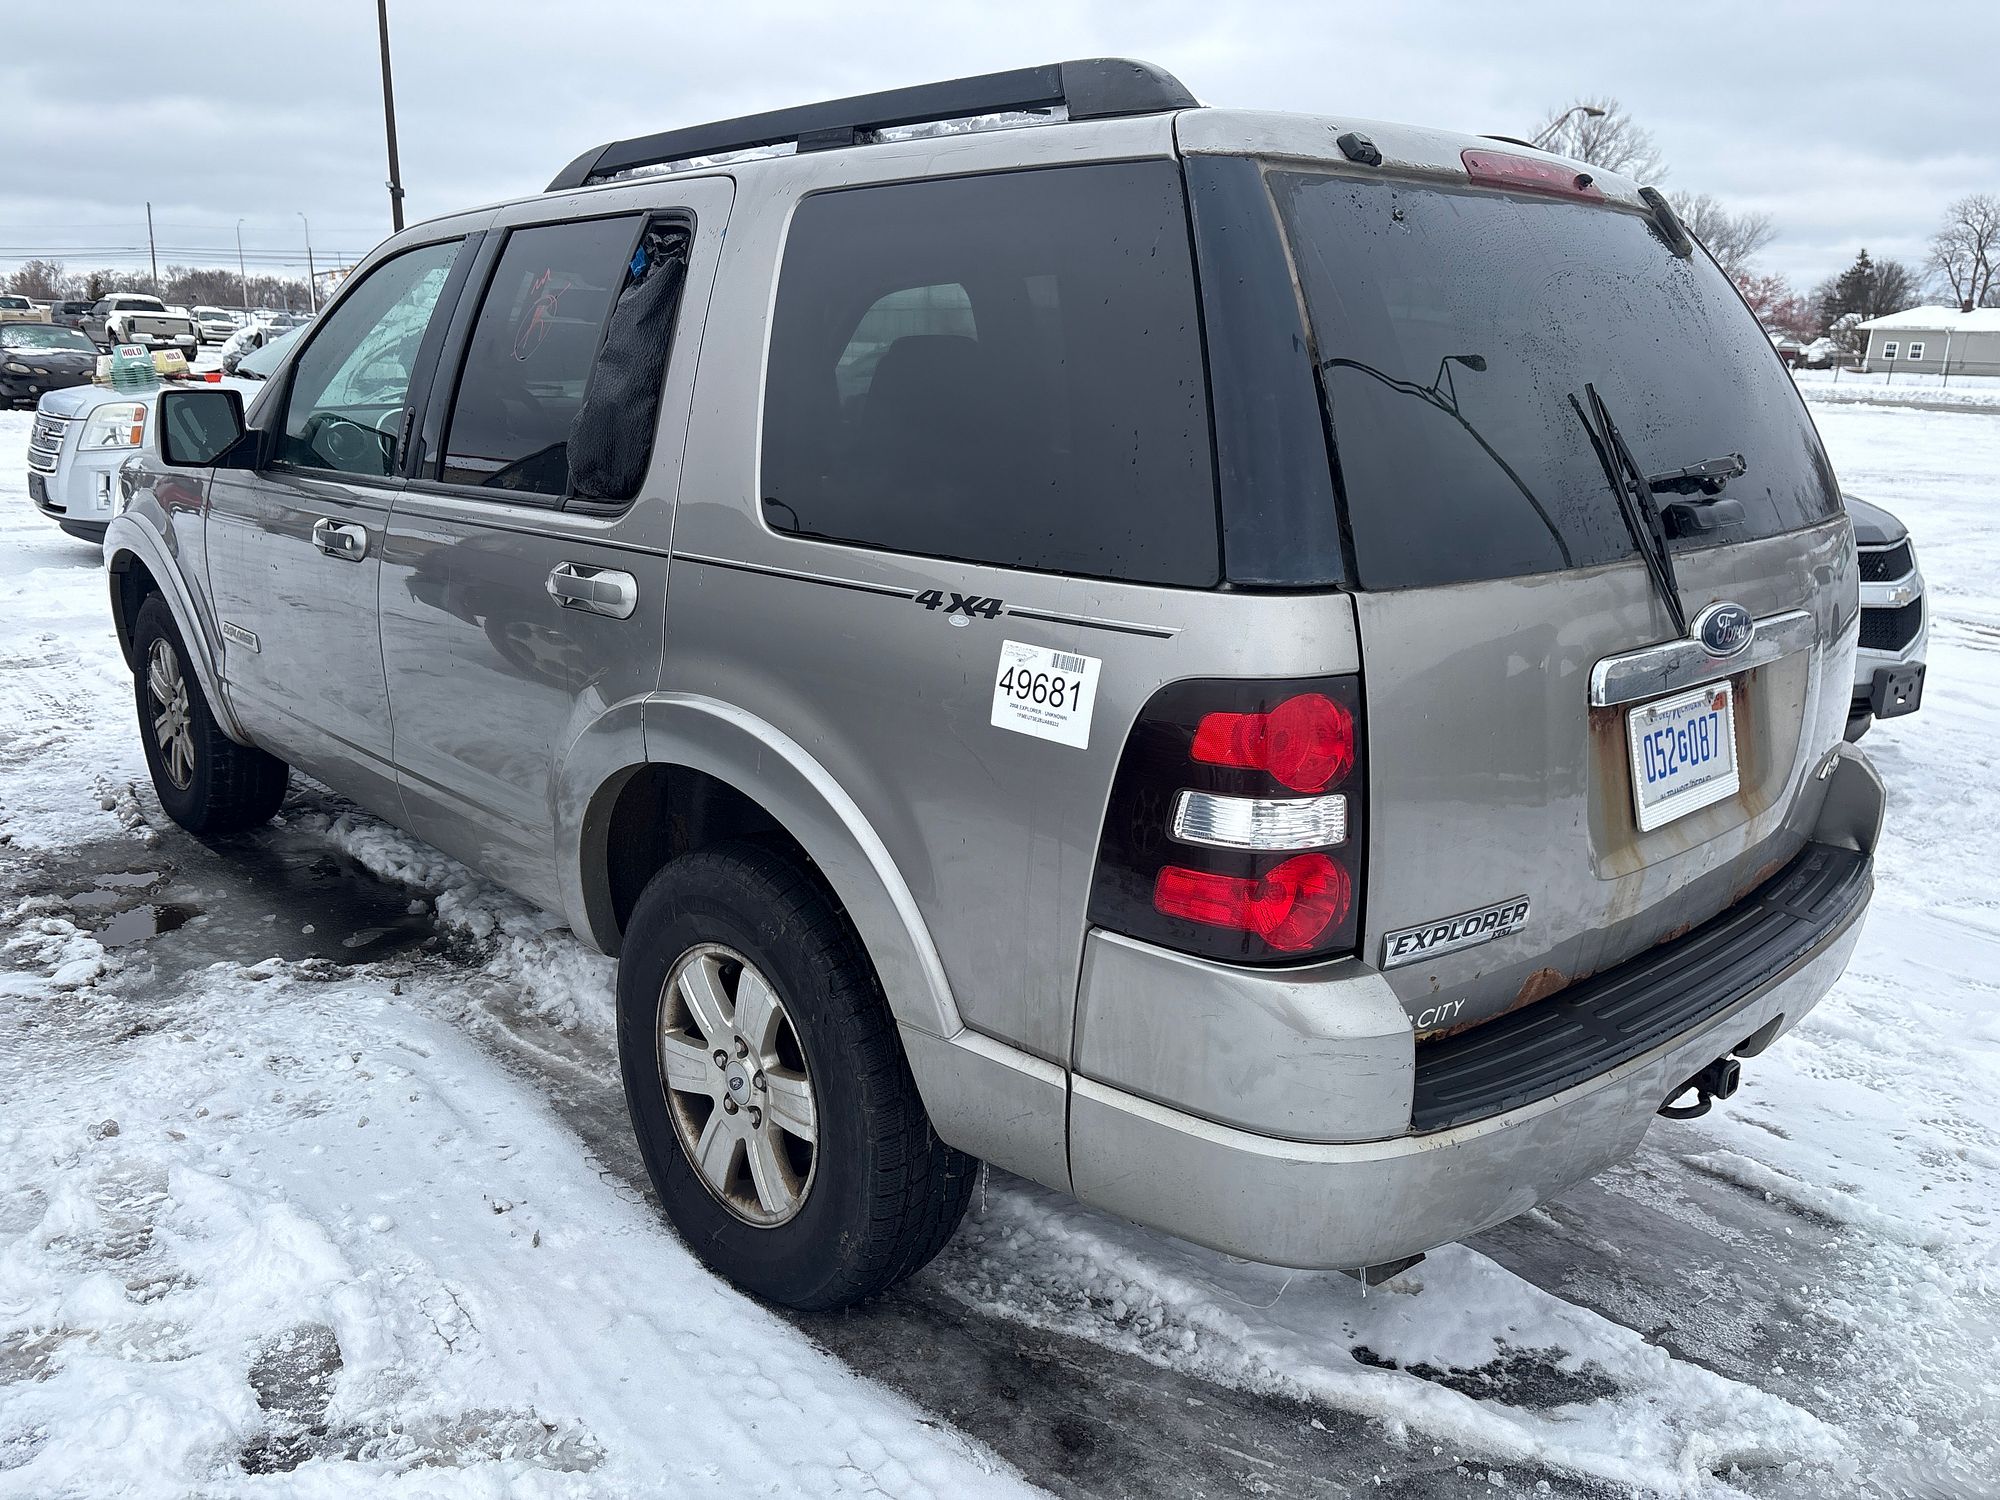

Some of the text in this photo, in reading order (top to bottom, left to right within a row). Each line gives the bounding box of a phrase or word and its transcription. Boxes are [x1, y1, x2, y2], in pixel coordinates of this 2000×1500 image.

[122, 347, 143, 357] HOLD
[165, 351, 181, 361] HOLD
[1716, 612, 1748, 645] Ford
[999, 666, 1081, 712] 49681
[1044, 711, 1068, 721] UNKNOWN
[1643, 712, 1718, 783] 052G087
[1392, 902, 1528, 957] EXPLORER
[1492, 927, 1511, 940] XLT
[1418, 999, 1466, 1029] CITY
